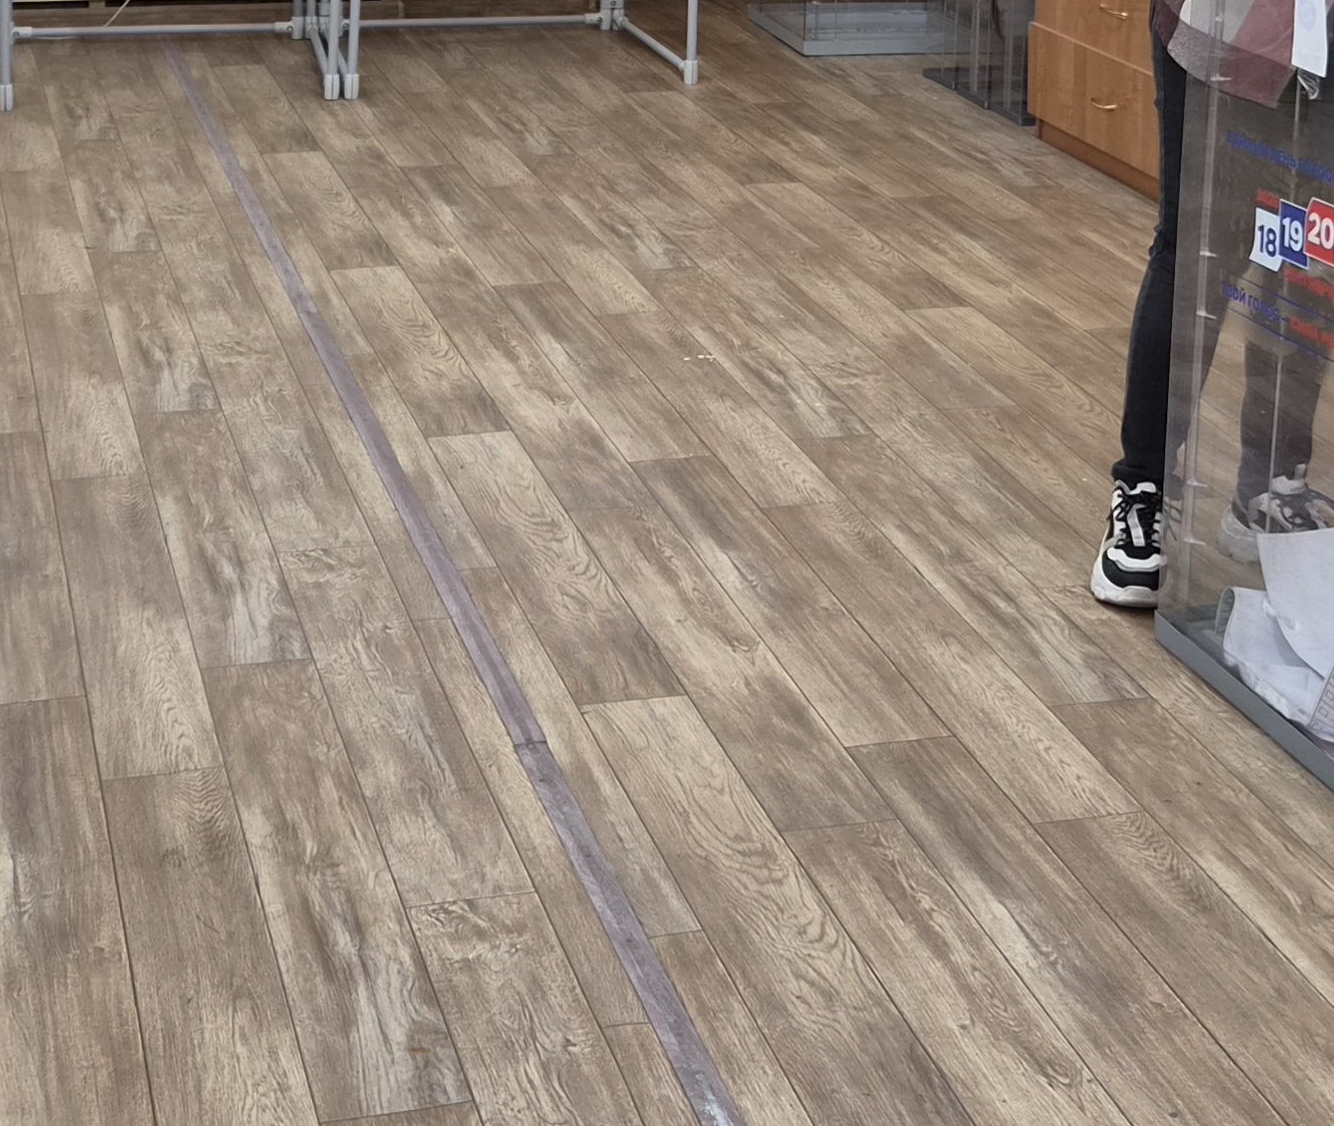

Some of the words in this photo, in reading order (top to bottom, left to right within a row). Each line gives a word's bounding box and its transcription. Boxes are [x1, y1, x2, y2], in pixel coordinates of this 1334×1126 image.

[1257, 224, 1278, 258] 18
[1282, 216, 1304, 251] 19
[1307, 212, 1334, 250] 20
